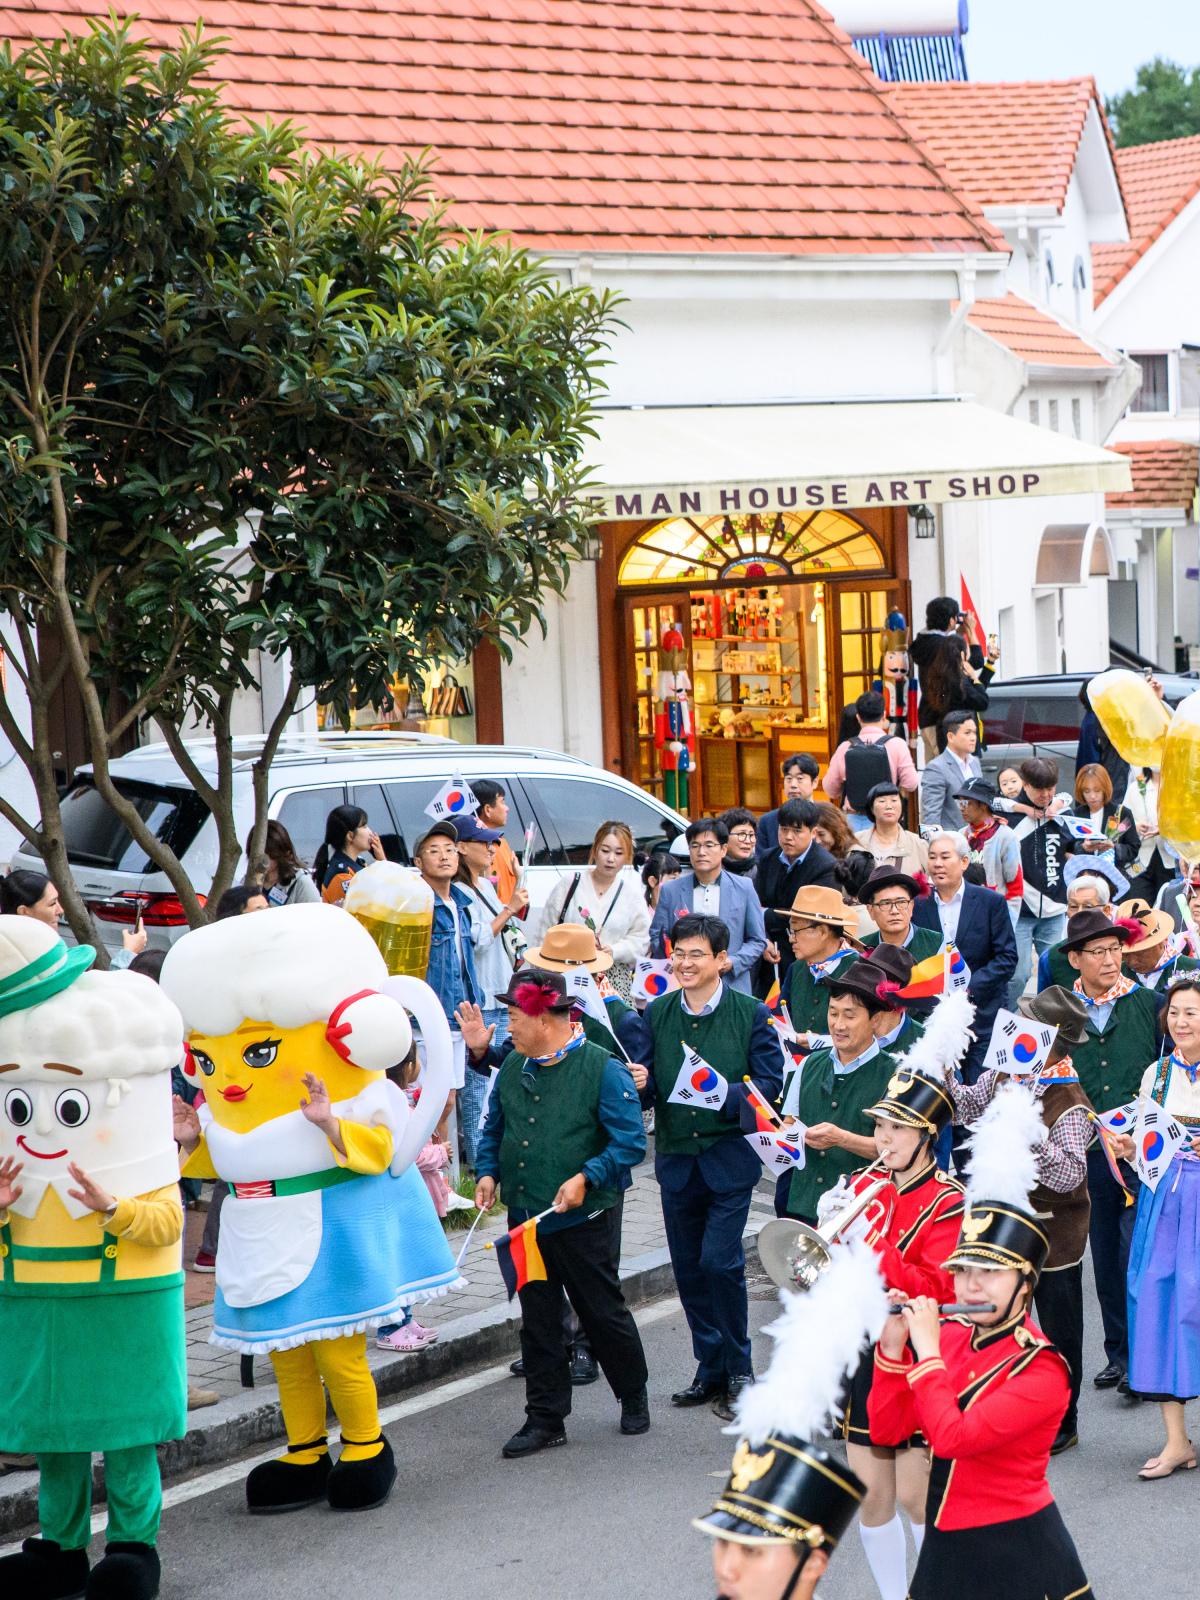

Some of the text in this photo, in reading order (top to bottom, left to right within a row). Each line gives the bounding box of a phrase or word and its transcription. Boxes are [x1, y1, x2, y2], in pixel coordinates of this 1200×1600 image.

[719, 484, 848, 511] HOUSE
[865, 479, 932, 503] ART
[948, 473, 1040, 499] SHOP
[1046, 834, 1061, 887] Kodak
